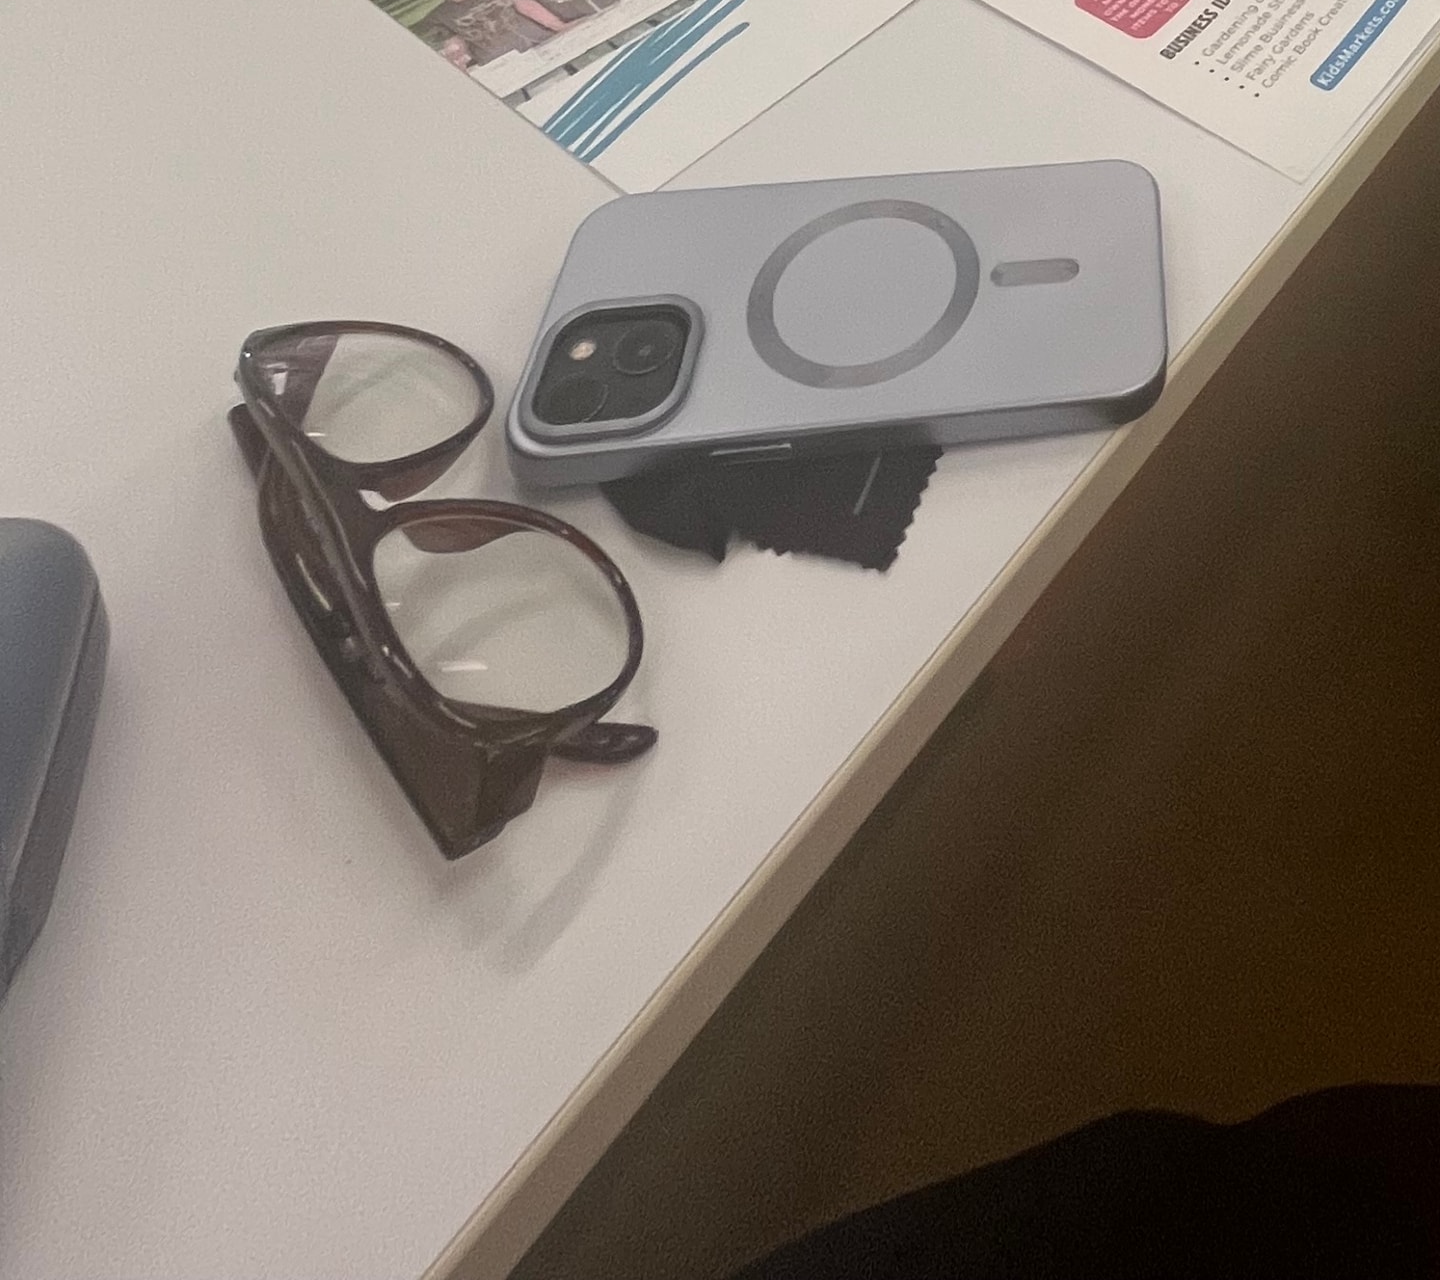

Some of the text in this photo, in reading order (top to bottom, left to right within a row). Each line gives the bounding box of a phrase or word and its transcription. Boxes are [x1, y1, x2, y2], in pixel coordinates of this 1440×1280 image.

[1159, 7, 1219, 60] BUSINESS
[1200, 3, 1260, 58] Gardening
[1215, 9, 1273, 66] Lemonade
[1229, 42, 1264, 74] Slime
[1244, 9, 1316, 82] Fairy Gardens
[1259, 53, 1297, 89] Comic
[1290, 24, 1323, 55] Book
